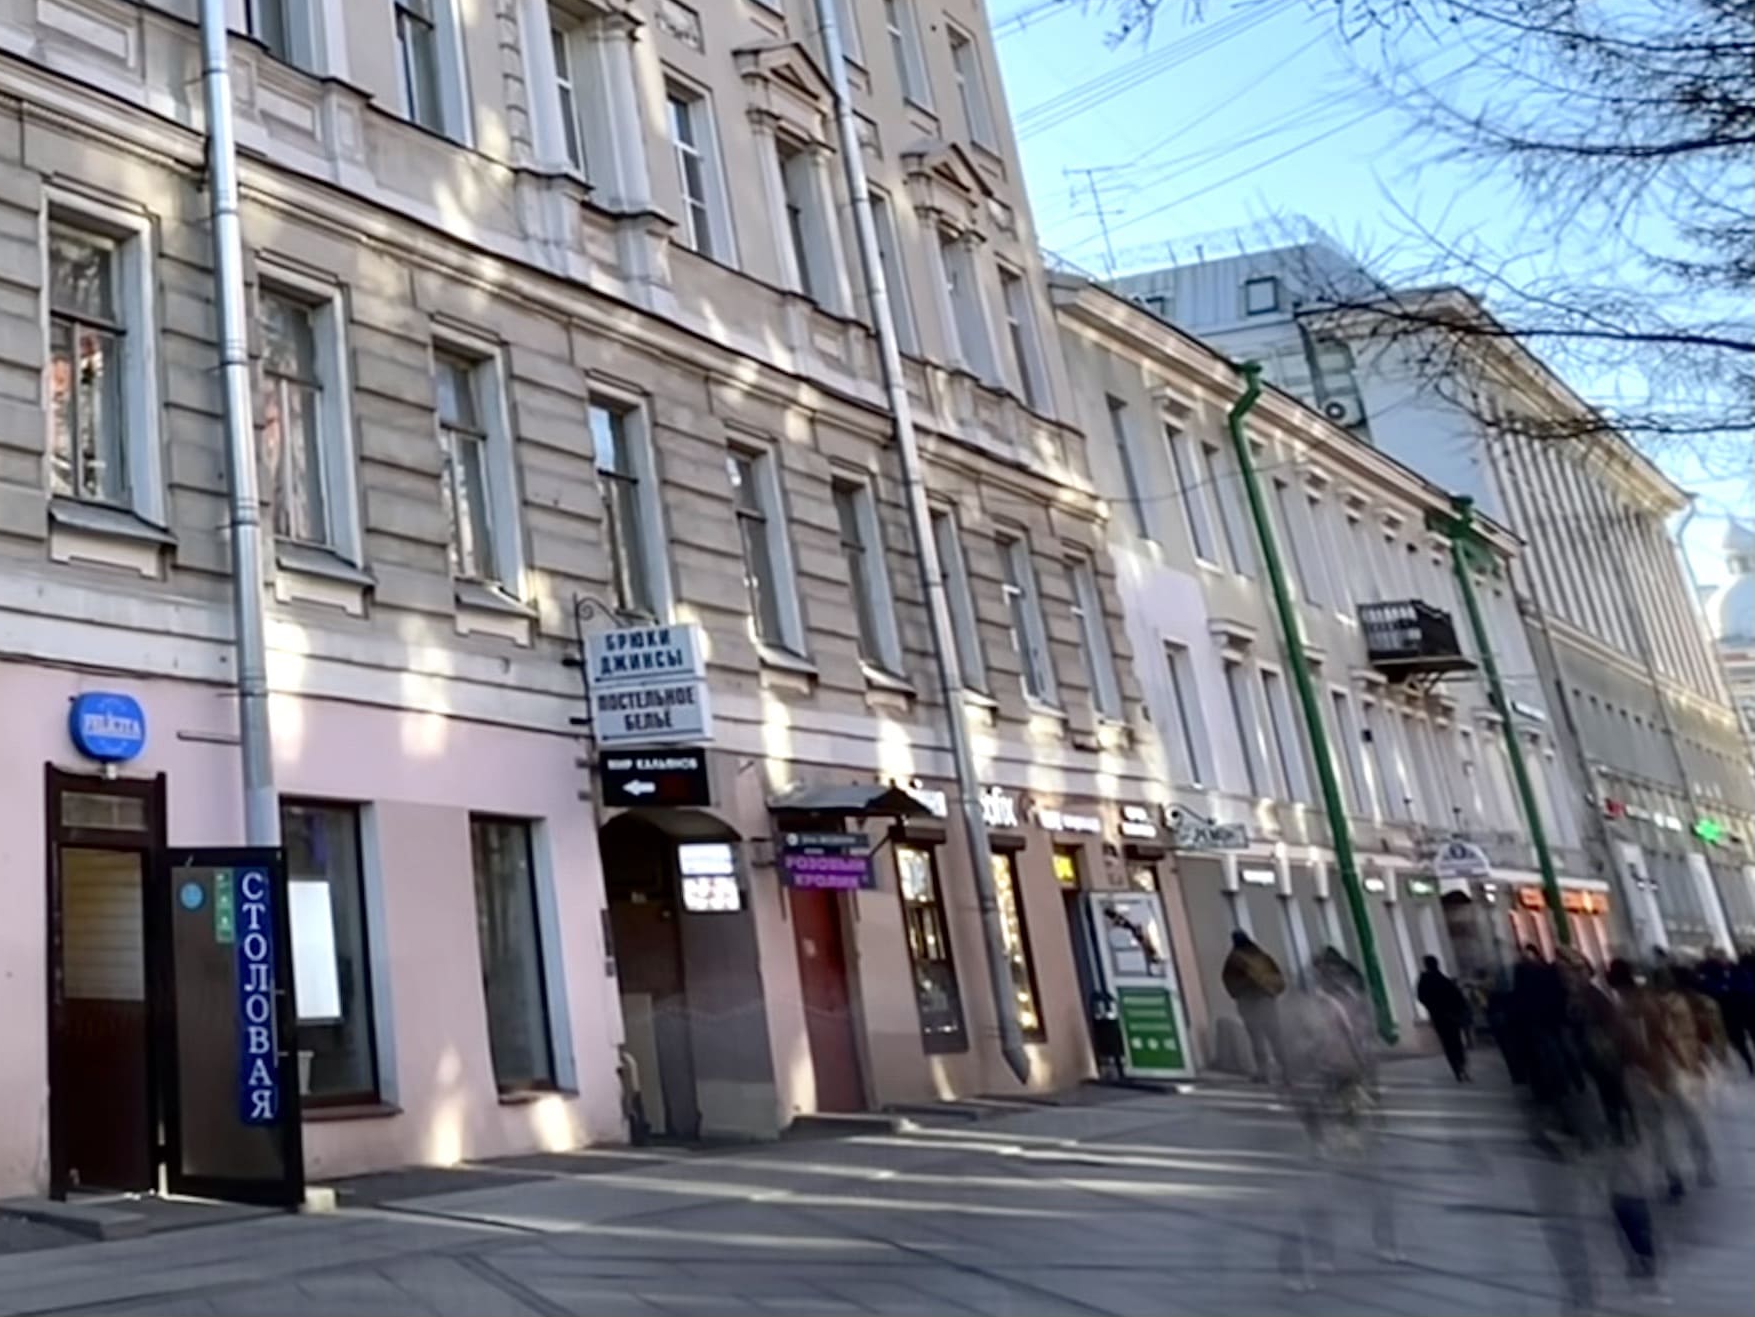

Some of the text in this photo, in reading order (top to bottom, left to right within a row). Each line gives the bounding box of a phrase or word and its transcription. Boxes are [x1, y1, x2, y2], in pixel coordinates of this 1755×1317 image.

[605, 628, 670, 651] БРЮКИ
[601, 648, 683, 675] ДЖИНСЫ
[598, 687, 694, 711] ПОСТЕЛЬНОЕ
[241, 871, 274, 1122] СТОЛОВАЯ
